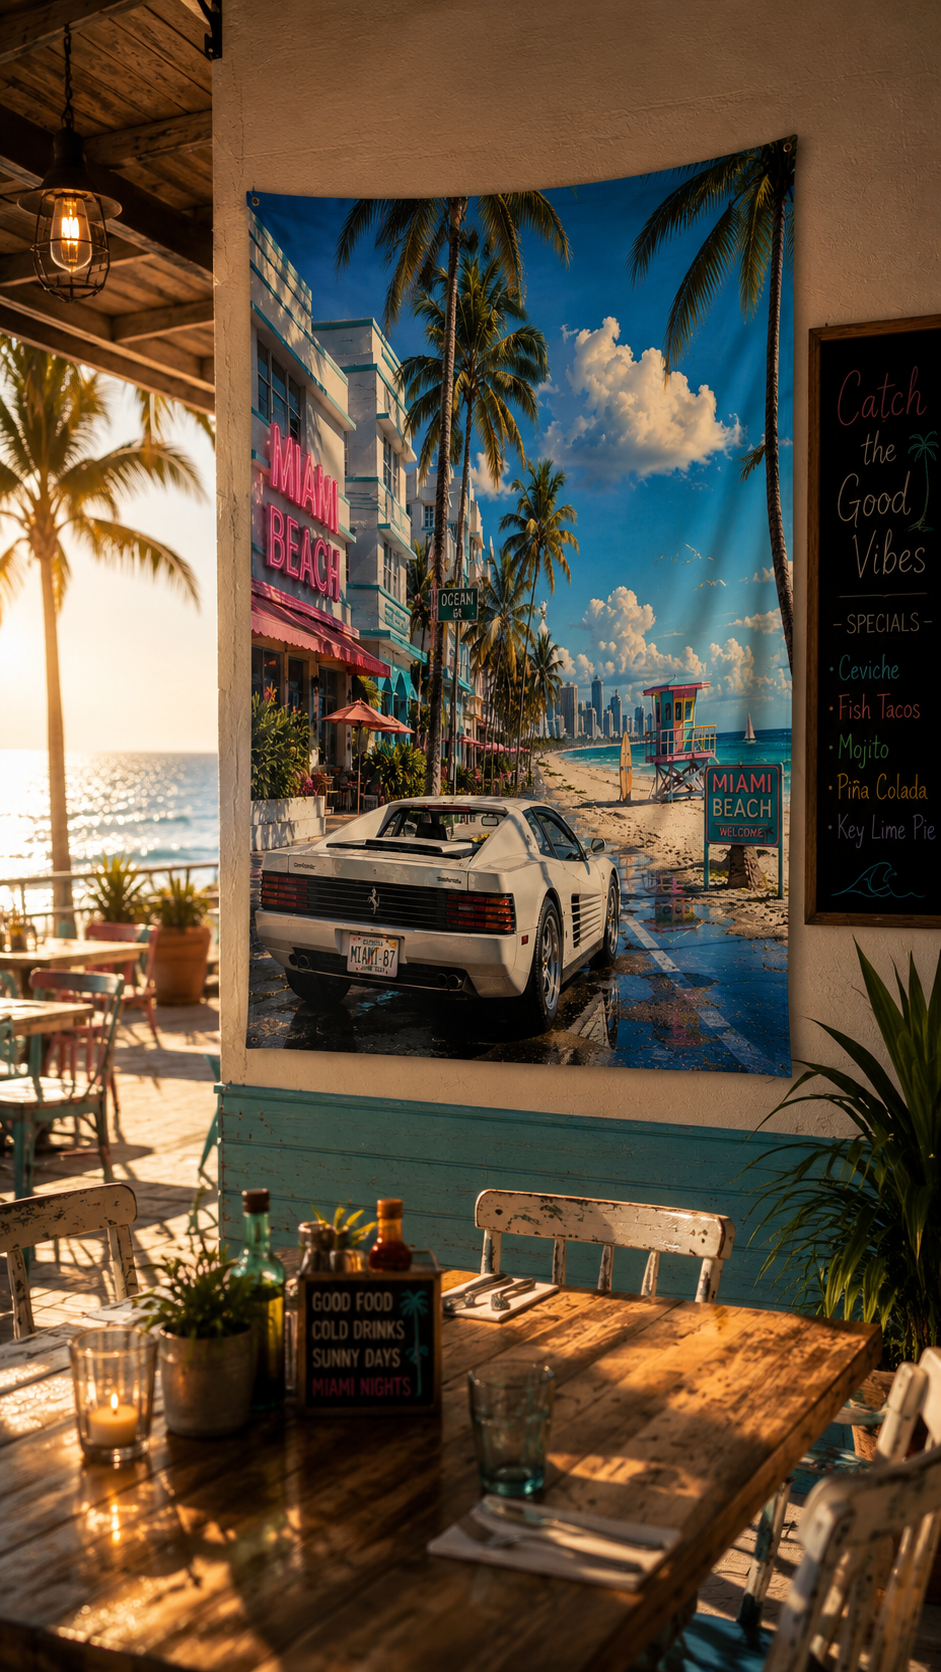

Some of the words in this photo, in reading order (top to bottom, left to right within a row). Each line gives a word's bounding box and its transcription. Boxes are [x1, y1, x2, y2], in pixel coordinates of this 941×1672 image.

[837, 366, 927, 426] Catch
[861, 430, 897, 465] the
[270, 422, 339, 535] MIAMI
[837, 471, 911, 528] Good
[266, 502, 340, 603] BEACH
[852, 529, 926, 578] Vibes
[441, 592, 474, 606] OCEAN
[838, 653, 900, 681] Ceviche
[838, 693, 871, 720] Fish
[877, 693, 921, 719] Tacos
[838, 733, 889, 769] Mojito
[712, 773, 772, 793] MIAMI
[837, 773, 870, 800] Piña
[876, 772, 928, 800] Colada
[712, 797, 772, 818] BEACH
[720, 827, 764, 838] WELCOME
[837, 813, 865, 849] Key
[871, 814, 907, 840] Lime
[912, 813, 937, 840] Pie
[312, 1291, 351, 1312] GOOD
[355, 1291, 393, 1312] FOOD
[312, 1320, 349, 1340] COLD
[353, 1320, 405, 1340] DRINKS
[312, 1347, 360, 1368] SUNNY
[365, 1347, 401, 1368] DAYS
[312, 1377, 355, 1397] MIAMI
[360, 1376, 412, 1397] NIGHTS
